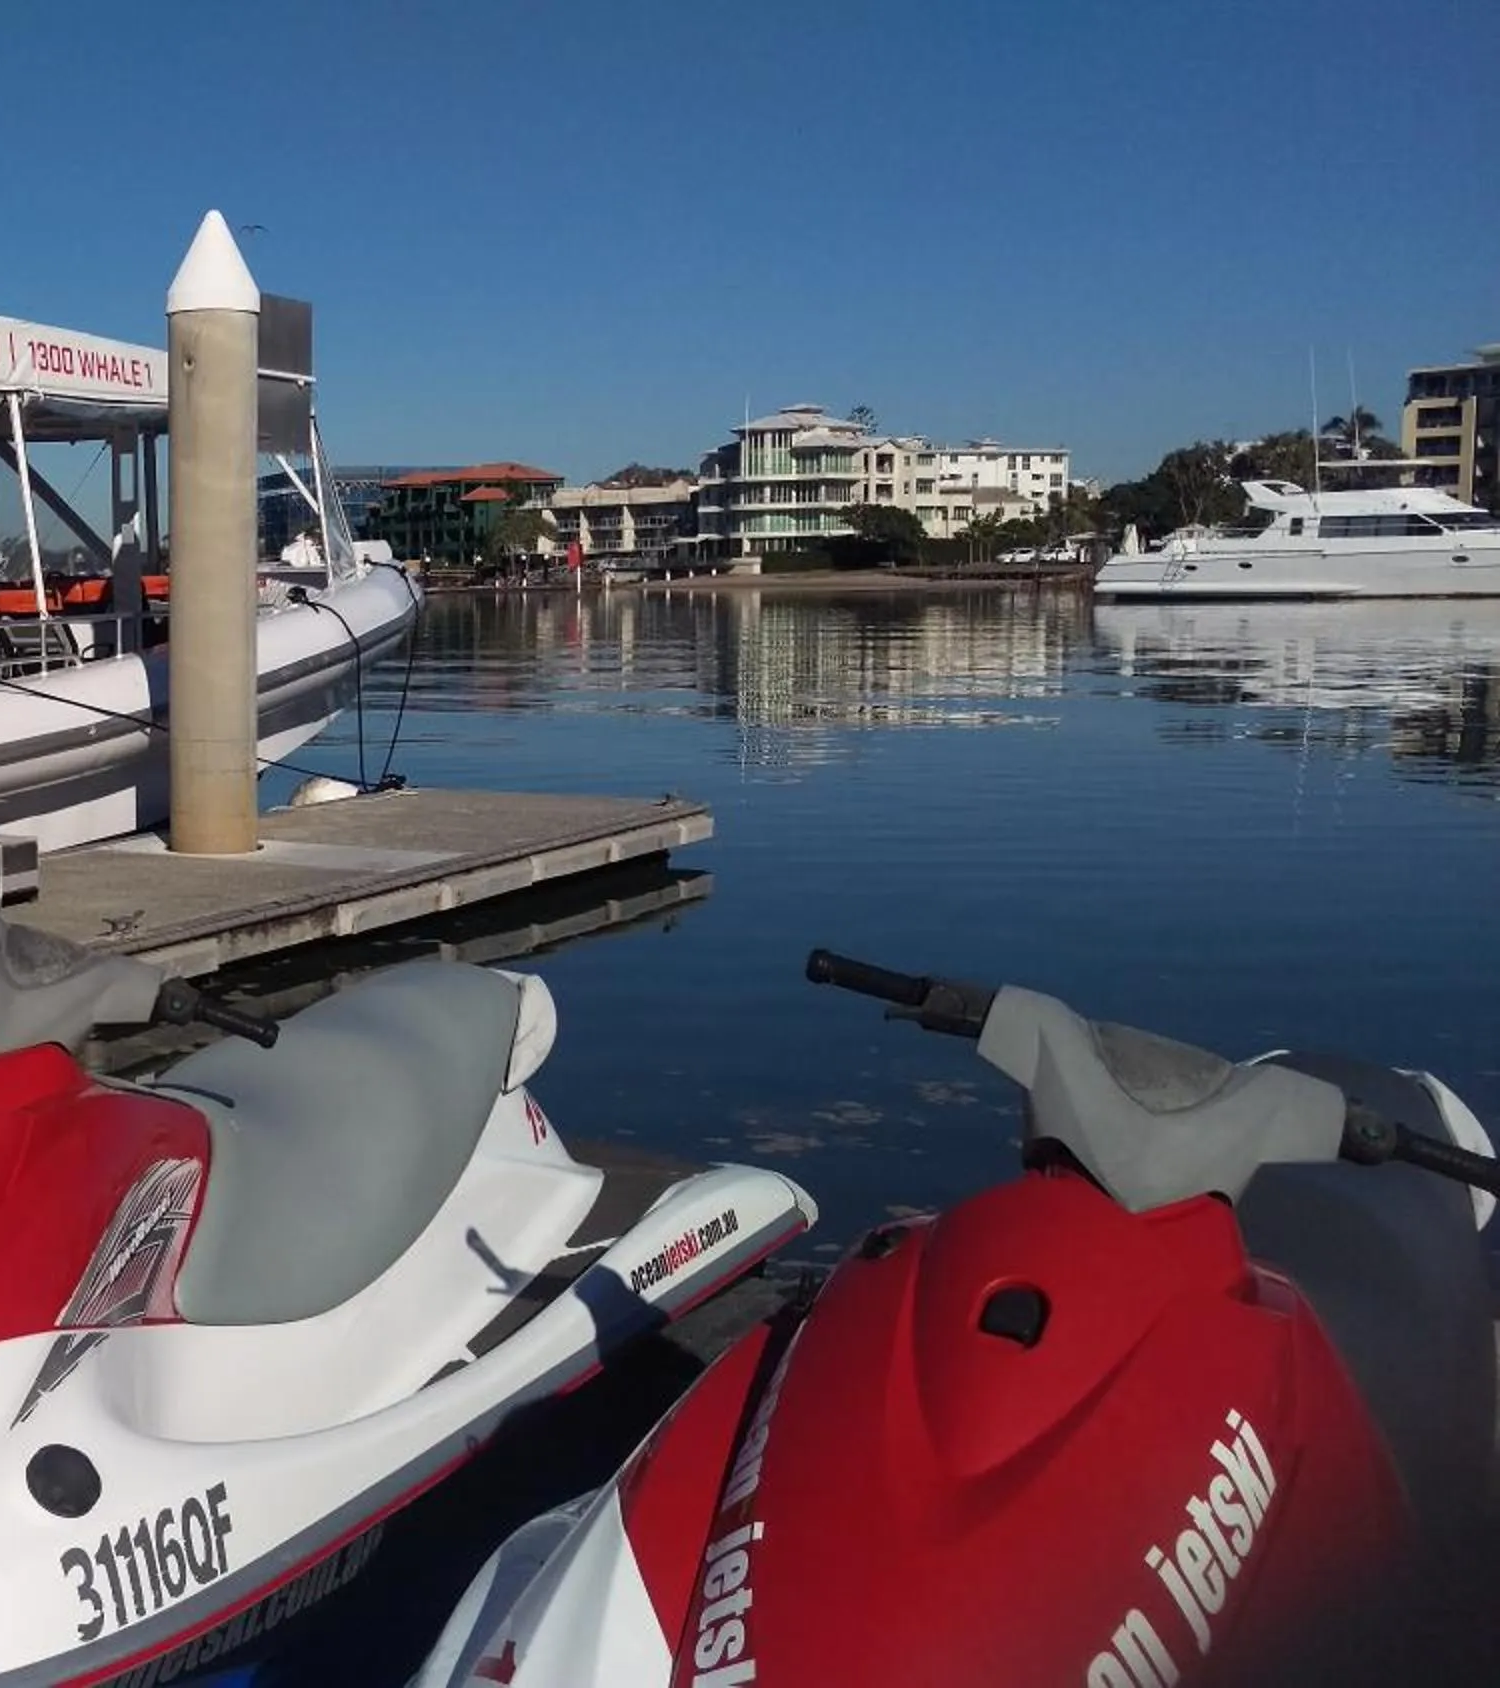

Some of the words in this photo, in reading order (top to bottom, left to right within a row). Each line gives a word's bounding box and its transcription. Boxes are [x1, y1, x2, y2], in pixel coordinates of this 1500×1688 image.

[28, 340, 74, 375] 1300
[77, 349, 143, 387] WHALE
[630, 1208, 739, 1294] oceanjetski.com.au
[59, 1481, 233, 1643] 31116QF
[1144, 1408, 1278, 1656] jetski
